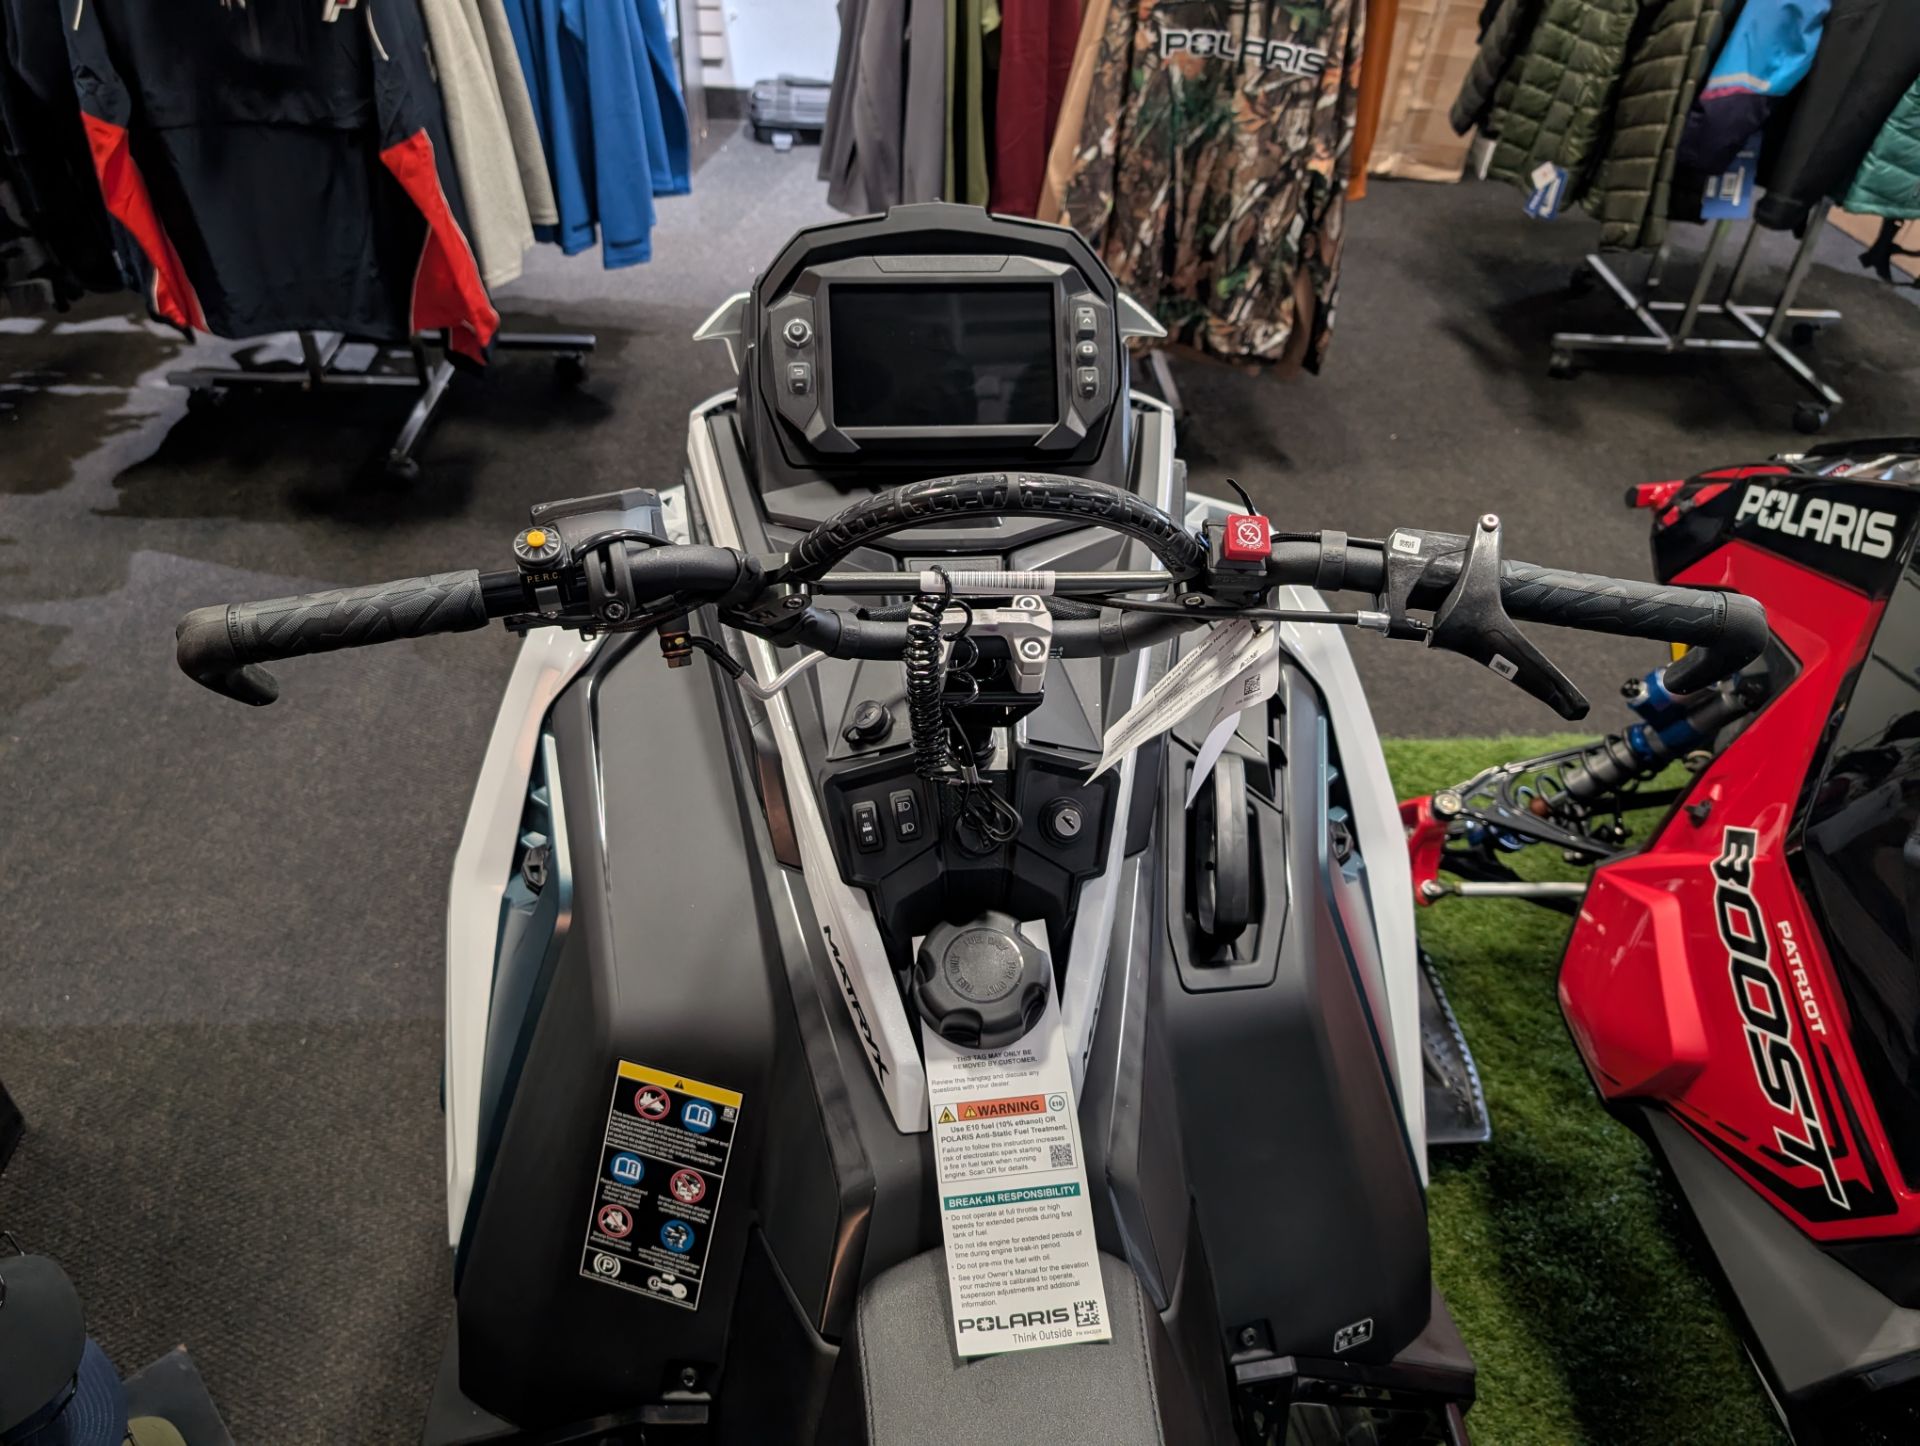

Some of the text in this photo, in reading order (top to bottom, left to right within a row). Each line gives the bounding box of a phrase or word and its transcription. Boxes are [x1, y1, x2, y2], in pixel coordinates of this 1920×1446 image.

[1160, 28, 1327, 76] POLARIS
[1736, 484, 1897, 559] POLARIS
[526, 572, 561, 583] P.E.R.C.
[1776, 920, 1826, 1036] PATRIOT
[823, 925, 890, 1085] MATRYX
[1714, 826, 1850, 1210] BOOST
[952, 1061, 985, 1070] REMOVED
[998, 1056, 1037, 1065] CUSTOMER.
[966, 1074, 991, 1083] hangtag
[1005, 1070, 1027, 1078] discuss
[932, 1085, 961, 1093] questions
[977, 1100, 1039, 1116] WARNING
[965, 1123, 979, 1131] E10
[995, 1120, 1012, 1128] (10%
[1014, 1117, 1043, 1126] ethanol)
[941, 1133, 973, 1143] POLARIS
[975, 1129, 1011, 1139] Anti-Static
[1030, 1124, 1067, 1133] Treatment.
[942, 1145, 962, 1153] Failure
[1003, 1138, 1034, 1147] instruction
[1035, 1135, 1065, 1143] increases
[962, 1150, 999, 1159] electrostatic
[1000, 1148, 1017, 1156] spark
[1018, 1145, 1041, 1154] starting
[1013, 1154, 1036, 1163] running
[948, 1185, 1075, 1207] BREAK-IN RESPONSIBILITY
[972, 1210, 997, 1219] operate
[1016, 1205, 1037, 1213] throttle
[1046, 1203, 1060, 1211] high
[951, 1221, 974, 1230] speeds
[985, 1217, 1014, 1225] extended
[1016, 1214, 1039, 1223] periods
[1040, 1211, 1059, 1220] during
[988, 1237, 1009, 1247] engine
[1021, 1233, 1050, 1241] extended
[1051, 1230, 1074, 1239] periods
[969, 1248, 989, 1258] during
[990, 1246, 1012, 1255] engine
[1013, 1243, 1039, 1251] break-in
[972, 1273, 986, 1281] your
[987, 1269, 1013, 1278] Owner's
[1014, 1266, 1037, 1274] Manual
[1060, 1260, 1088, 1269] elevation
[978, 1258, 1002, 1268] pre-mix
[959, 1284, 973, 1292] your
[974, 1280, 1000, 1288] machine
[1009, 1275, 1039, 1284] calibrated
[960, 1290, 995, 1301] suspension
[996, 1285, 1034, 1296] adjustments
[1049, 1280, 1080, 1289] additional
[961, 1298, 997, 1309] information.
[958, 1306, 1070, 1334] POLARIS
[1012, 1331, 1037, 1344] Think
[1038, 1327, 1072, 1341] Outside
